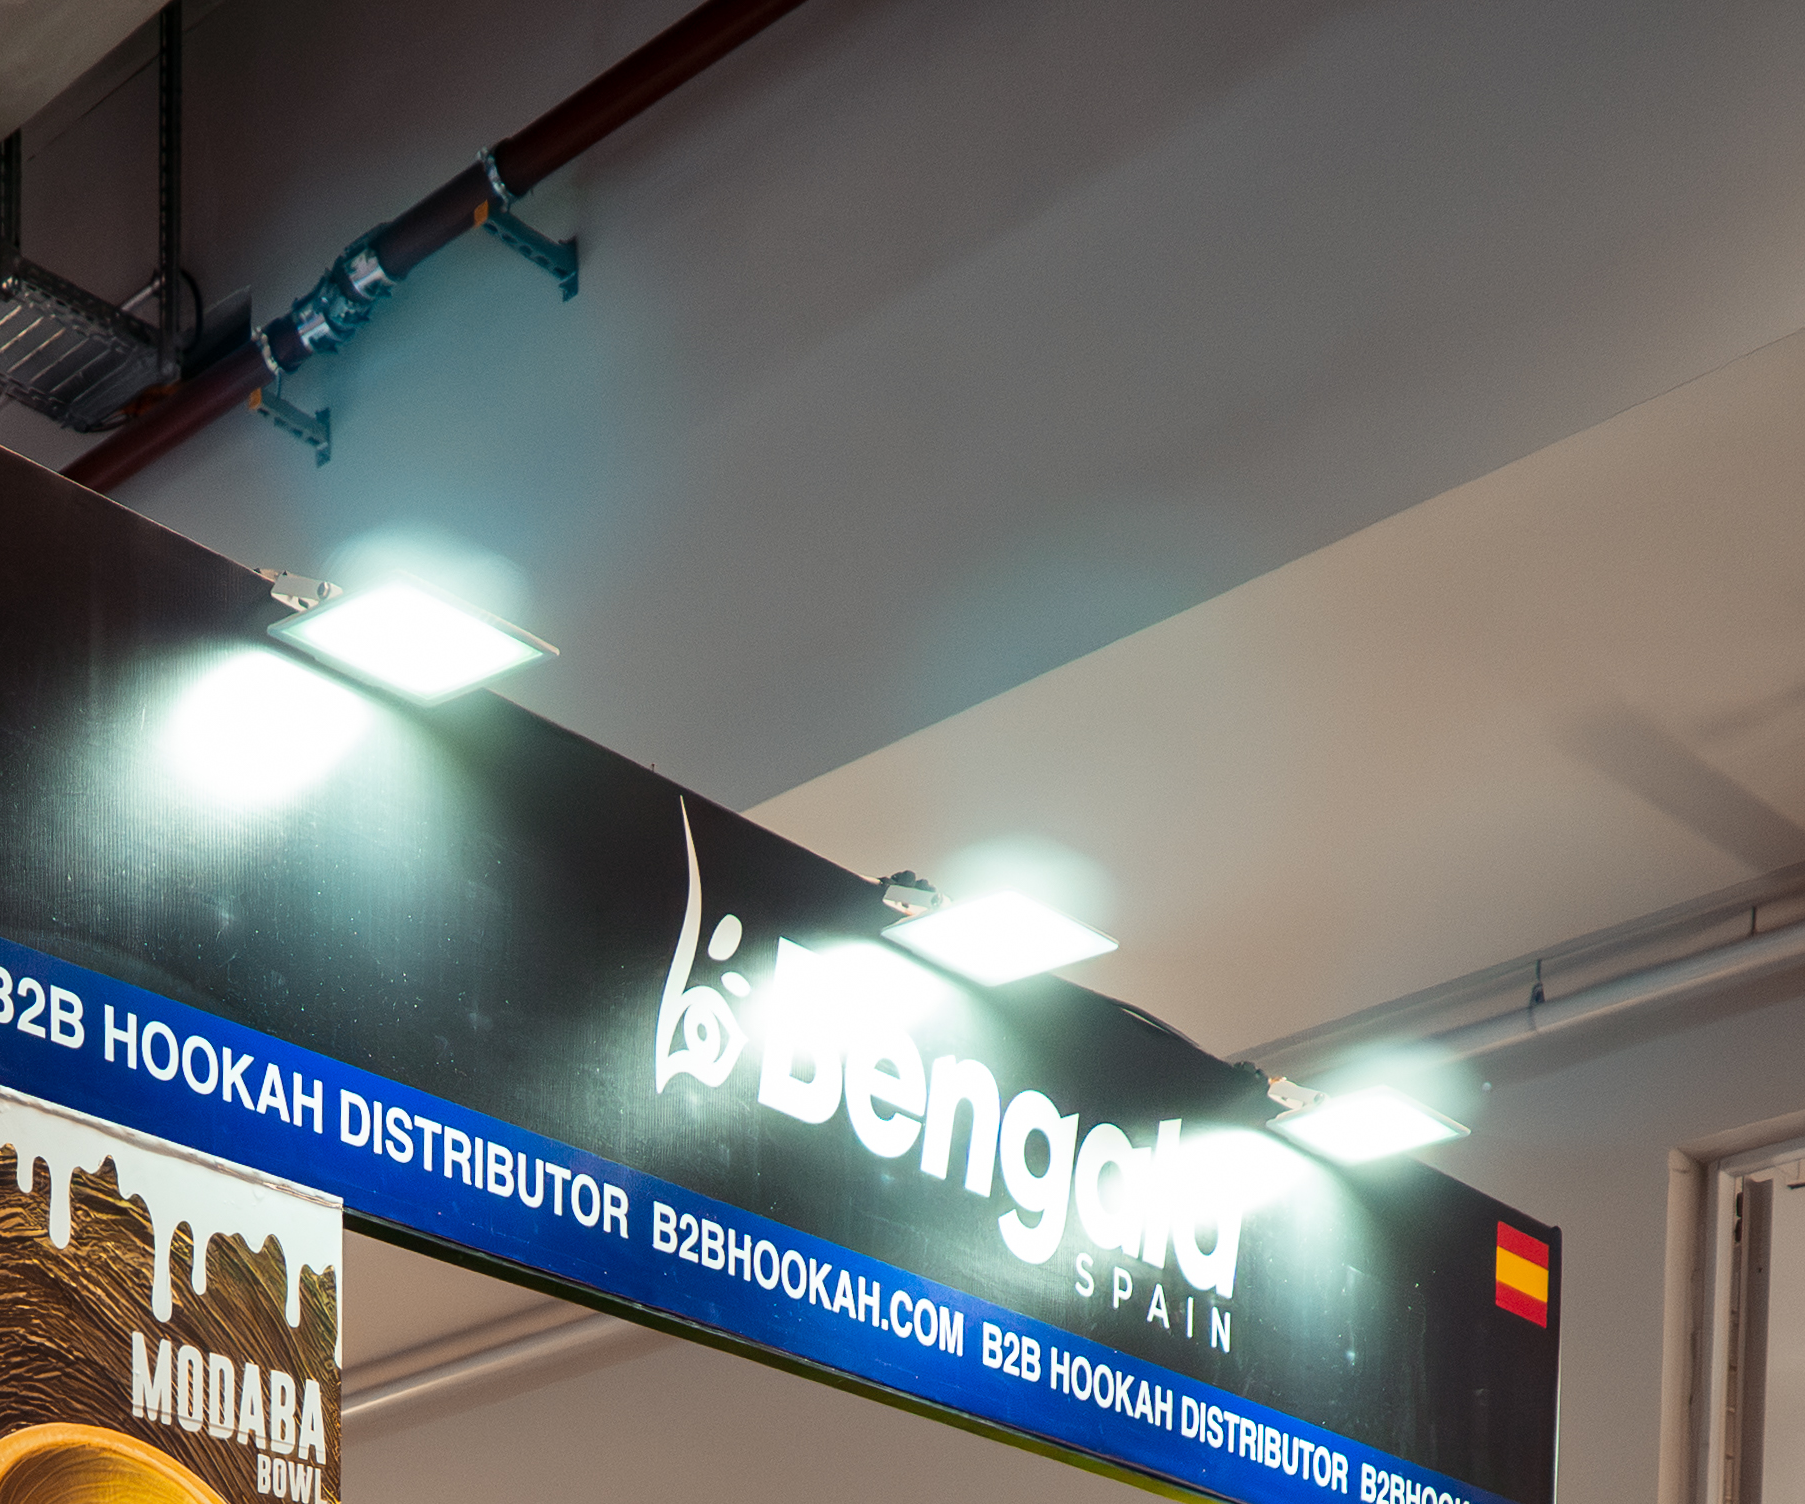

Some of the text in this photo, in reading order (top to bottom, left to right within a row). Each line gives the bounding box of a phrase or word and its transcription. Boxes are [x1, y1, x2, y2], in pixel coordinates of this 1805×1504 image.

[758, 936, 1244, 1299] Bengala
[103, 1004, 325, 1135] HOOKAH
[340, 1089, 628, 1240] DISTRIBUTOR
[652, 1200, 964, 1357] B2BHOOKAH.COM
[982, 1320, 1042, 1384] B2B
[1050, 1345, 1173, 1431] HOOKAH
[1181, 1396, 1349, 1495] DISTRIBUTOR
[1075, 1251, 1232, 1354] SPAIN
[131, 1330, 327, 1467] MODABA
